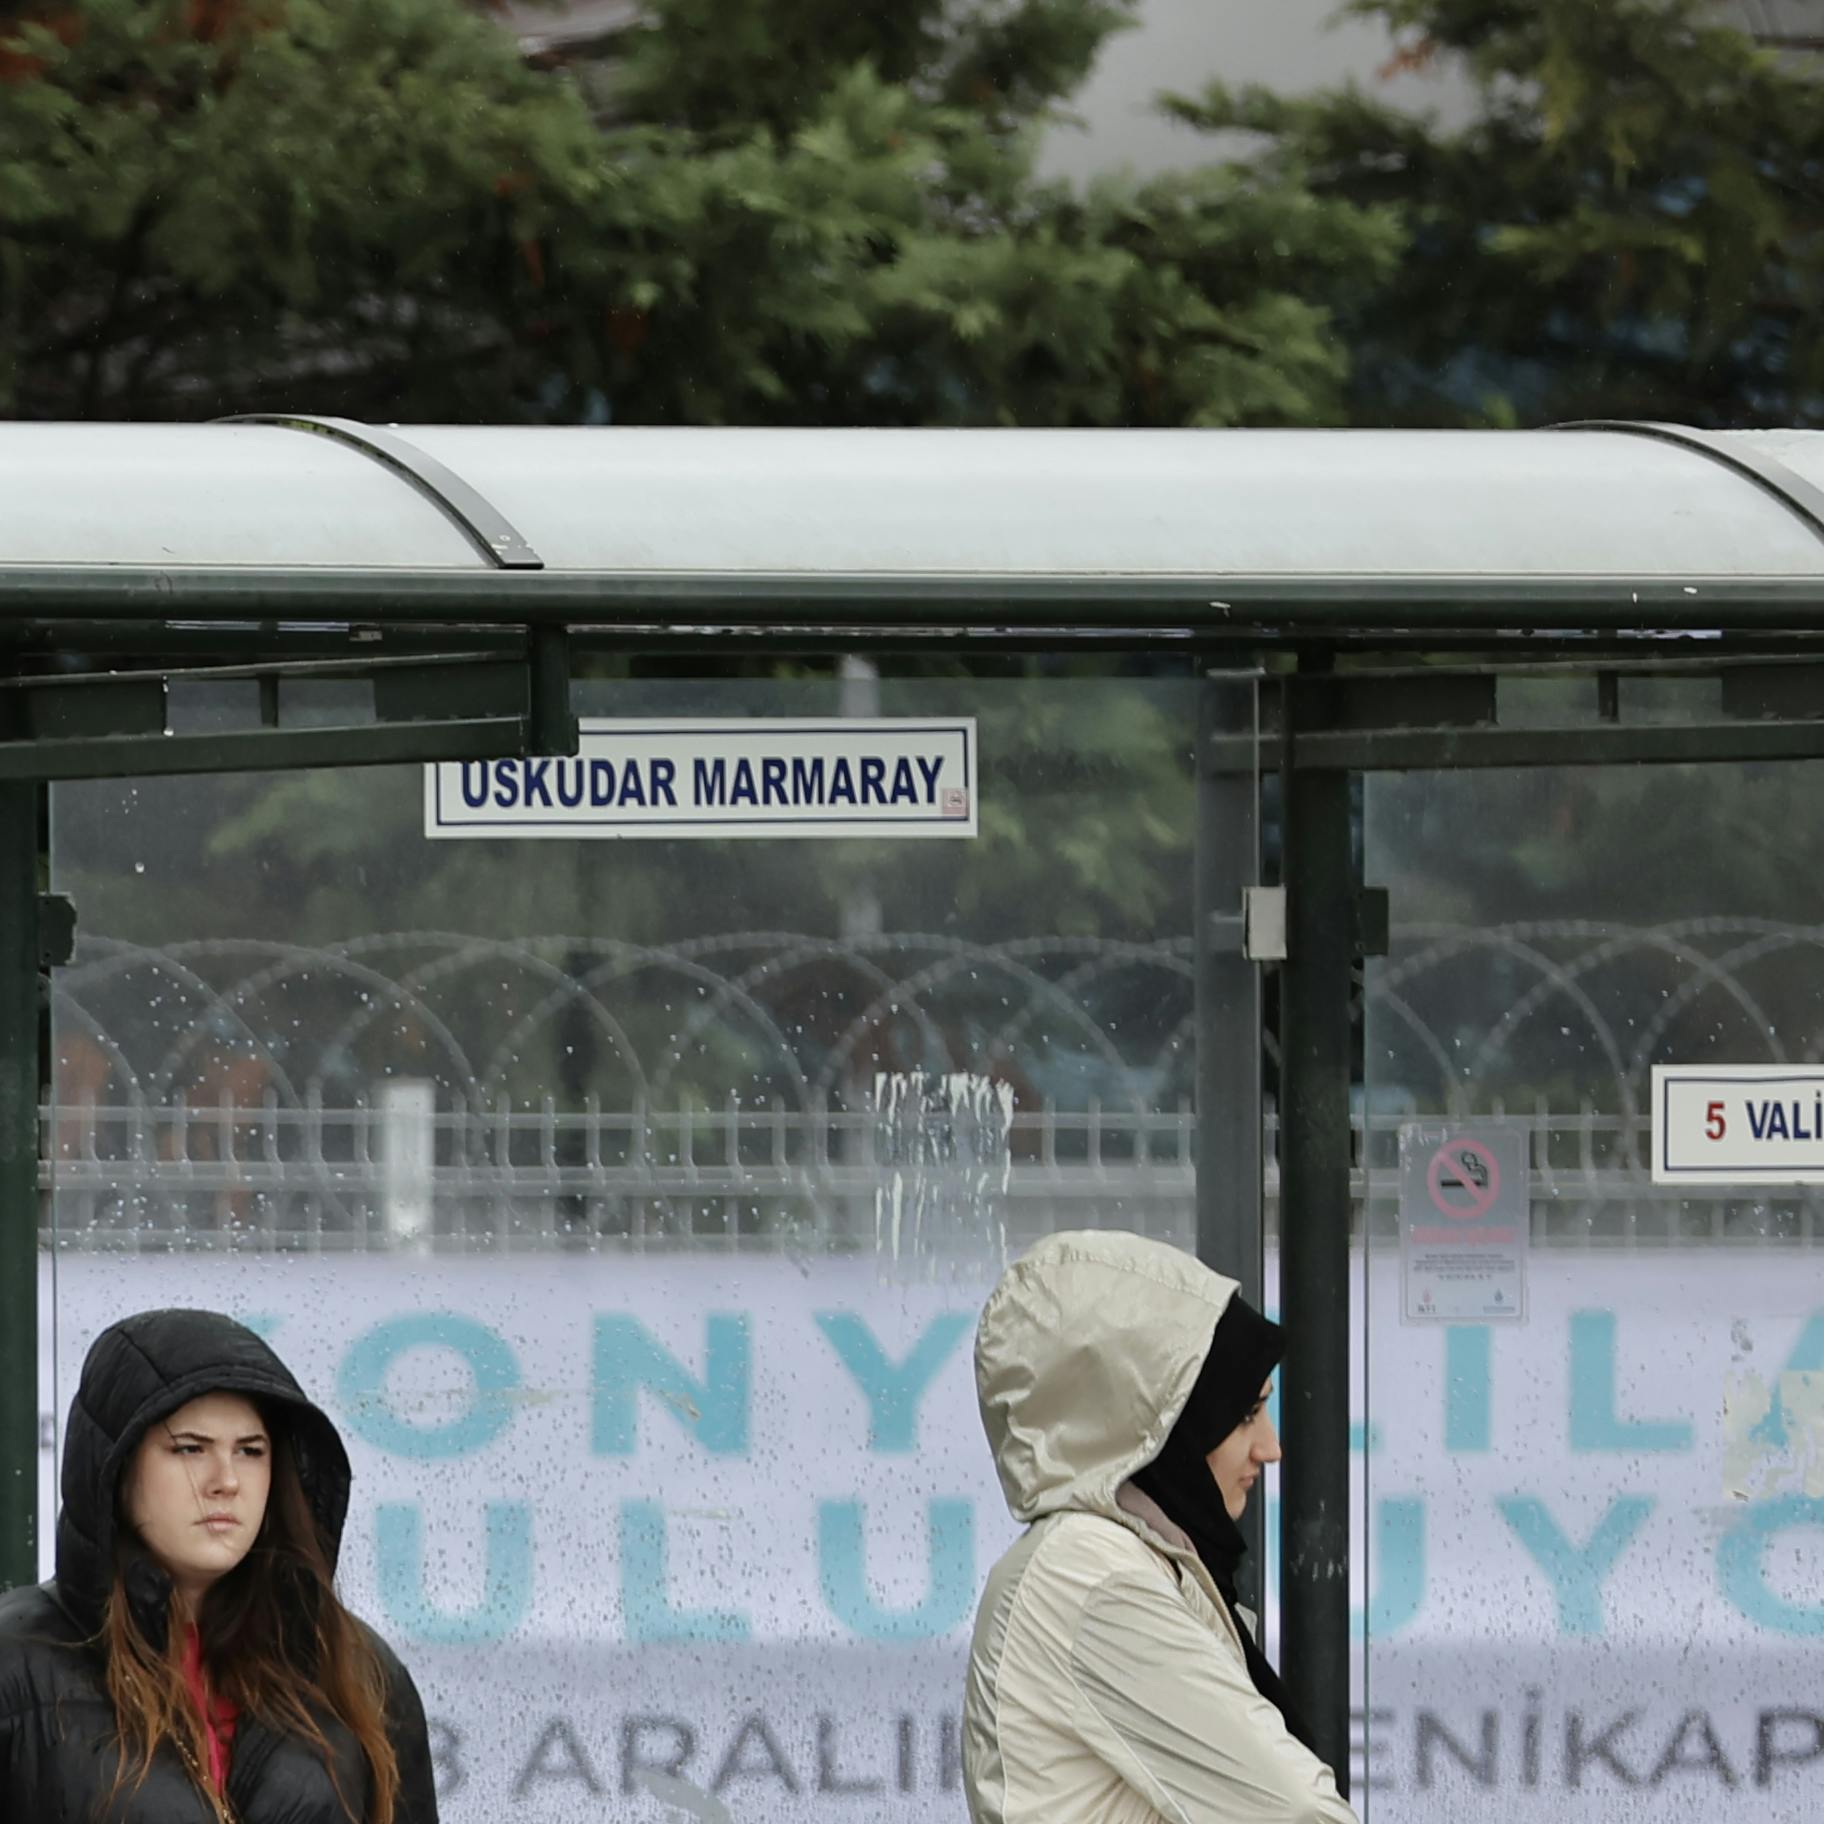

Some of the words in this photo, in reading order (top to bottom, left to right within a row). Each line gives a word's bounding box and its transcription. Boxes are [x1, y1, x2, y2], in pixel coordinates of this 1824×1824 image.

[692, 755, 945, 806] MARMARAY
[1704, 1100, 1727, 1141] 5
[1744, 1089, 1823, 1141] VALİ
